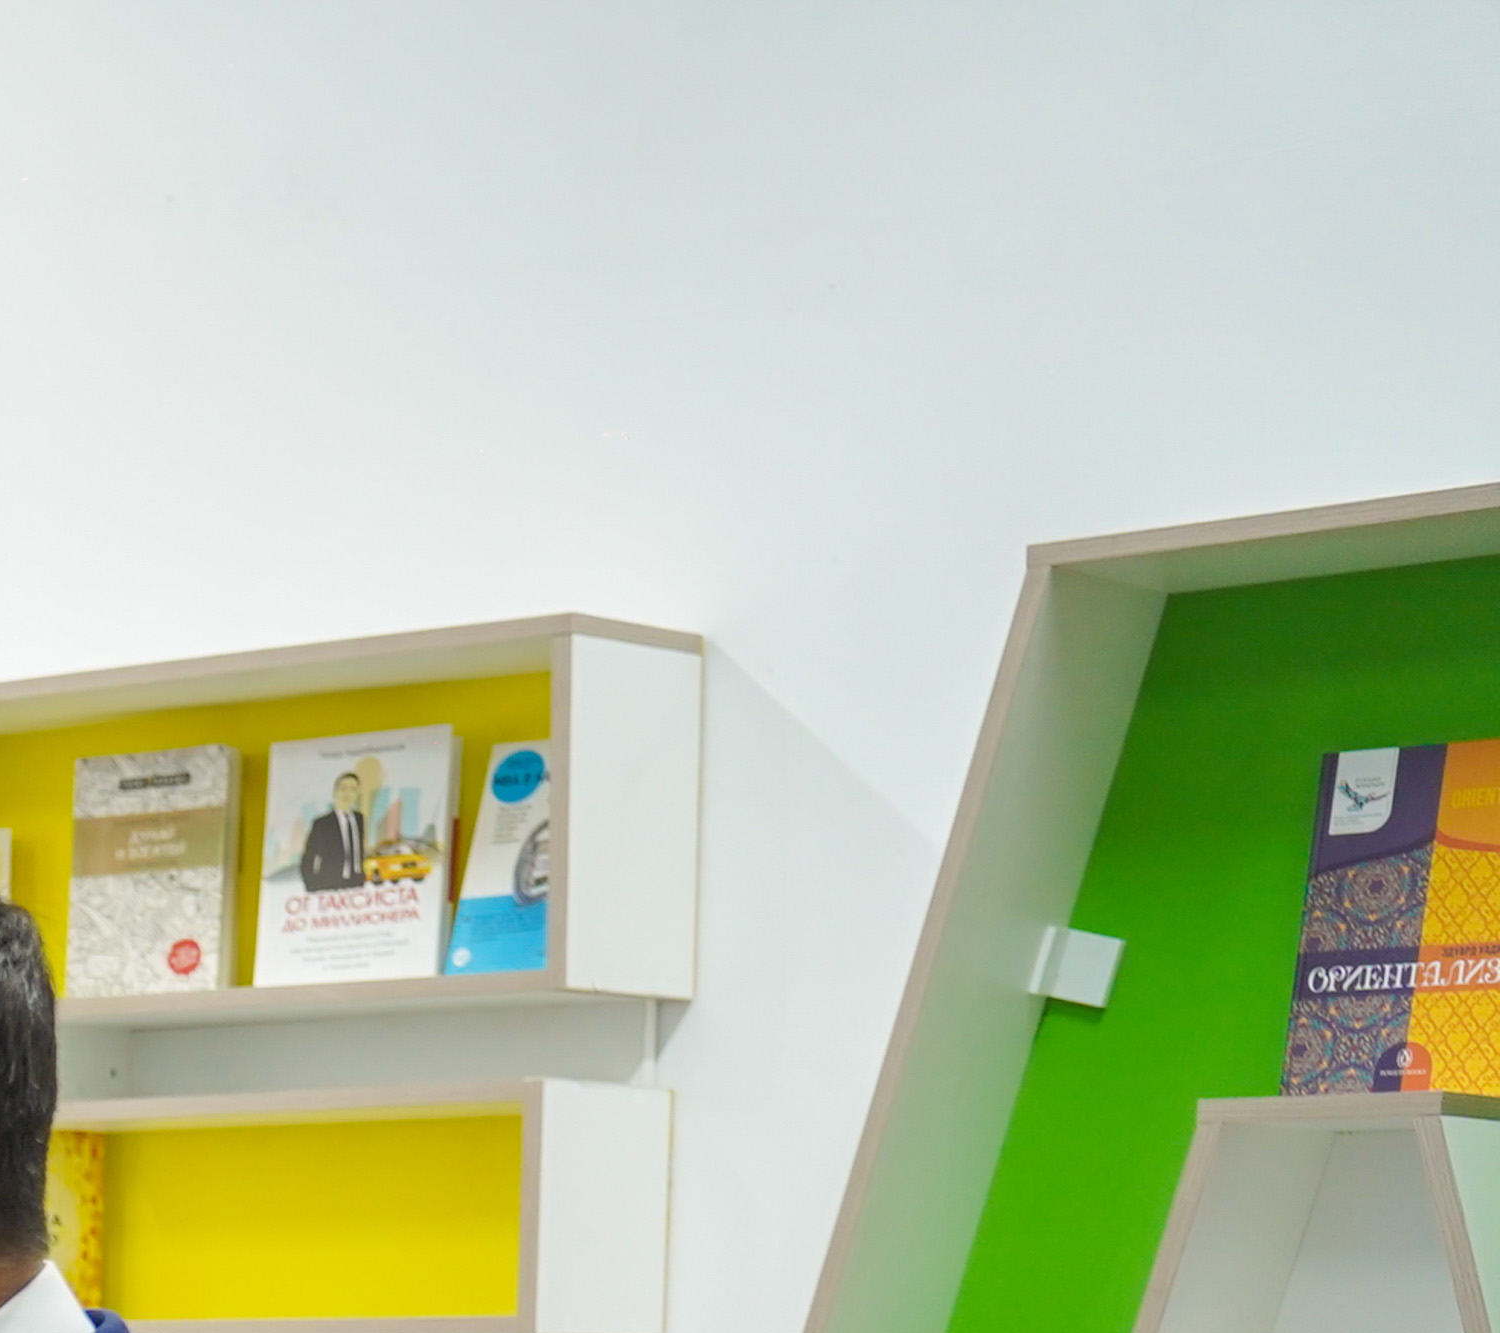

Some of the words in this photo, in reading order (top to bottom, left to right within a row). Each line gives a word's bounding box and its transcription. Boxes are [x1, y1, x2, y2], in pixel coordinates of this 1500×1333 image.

[284, 895, 311, 916] ОТ
[316, 885, 420, 913] ТАКСИСТА
[282, 918, 307, 934] ДО
[311, 905, 420, 932] МИЛЛИОНЕРА
[1308, 957, 1500, 993] ОРИЕНТАЛИЗ
